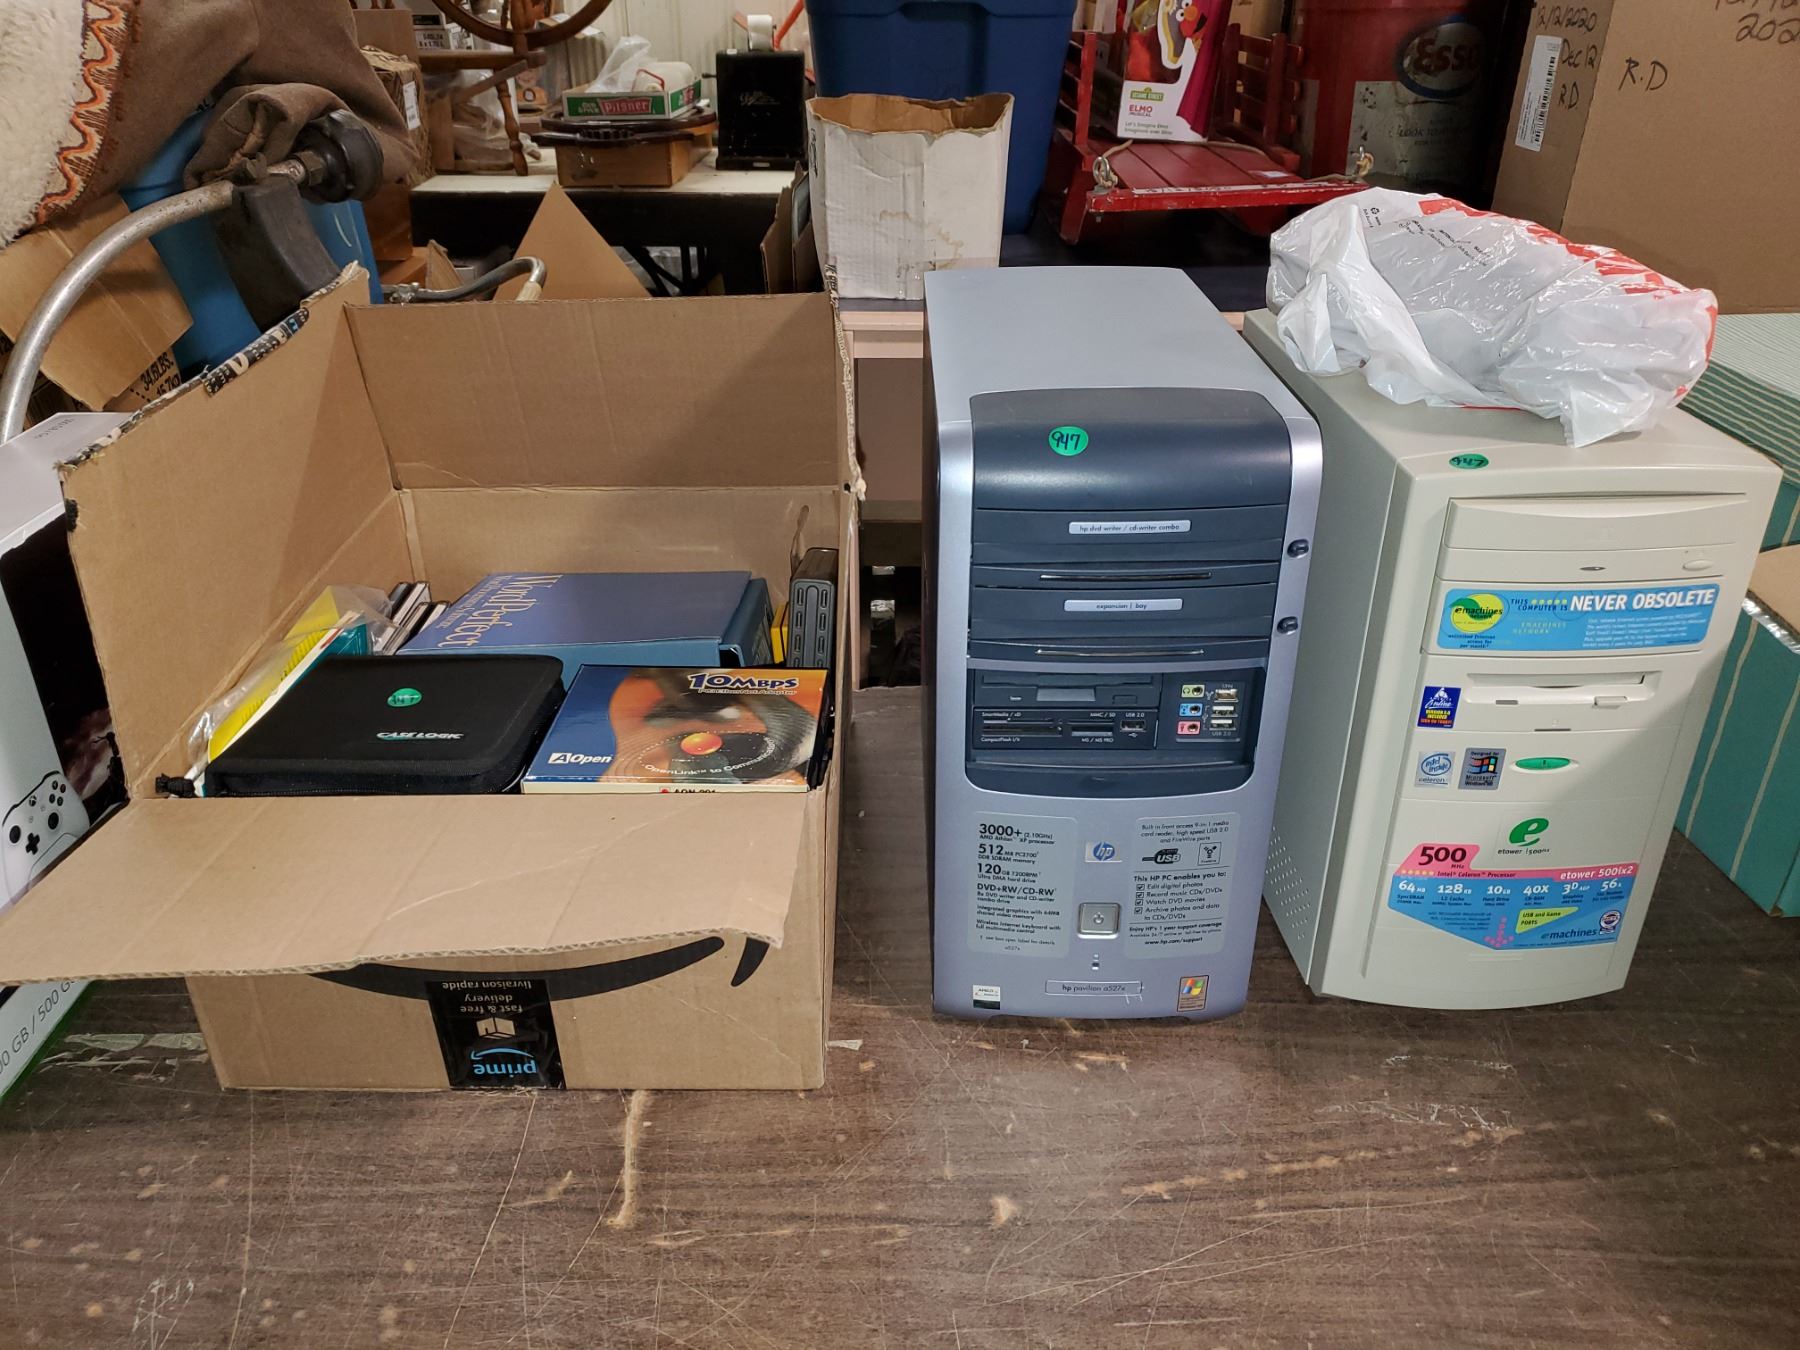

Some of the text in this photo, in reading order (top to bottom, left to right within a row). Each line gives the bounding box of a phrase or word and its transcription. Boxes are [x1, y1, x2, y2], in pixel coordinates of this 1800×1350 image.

[1129, 104, 1153, 113] ELMO
[1051, 431, 1081, 450] 947
[1570, 588, 1716, 612] NEVER OBSOLETE
[437, 574, 564, 649] WordPerfect
[979, 823, 1023, 837] 3000+
[978, 843, 1004, 855] 512
[1096, 842, 1114, 861] hp
[1156, 853, 1181, 863] USB
[1418, 846, 1467, 866] 500
[977, 862, 1002, 875] 120
[1560, 865, 1634, 881] etower 500ix2
[1173, 872, 1200, 880] enables
[1202, 872, 1215, 880] you
[1398, 879, 1416, 893] 64
[1437, 883, 1464, 894] 128
[1487, 885, 1503, 895] 10
[1523, 884, 1550, 897] 40X
[1562, 882, 1579, 895] 3D
[1601, 878, 1618, 892] 56
[442, 980, 532, 991] livraison rapide
[1062, 985, 1072, 993] hp
[1073, 984, 1102, 993] pavilion
[464, 993, 512, 1003] delivery
[460, 1004, 523, 1014] fast & free
[12, 1026, 29, 1053] GB
[38, 989, 59, 1022] 500
[472, 1060, 537, 1078] prime
